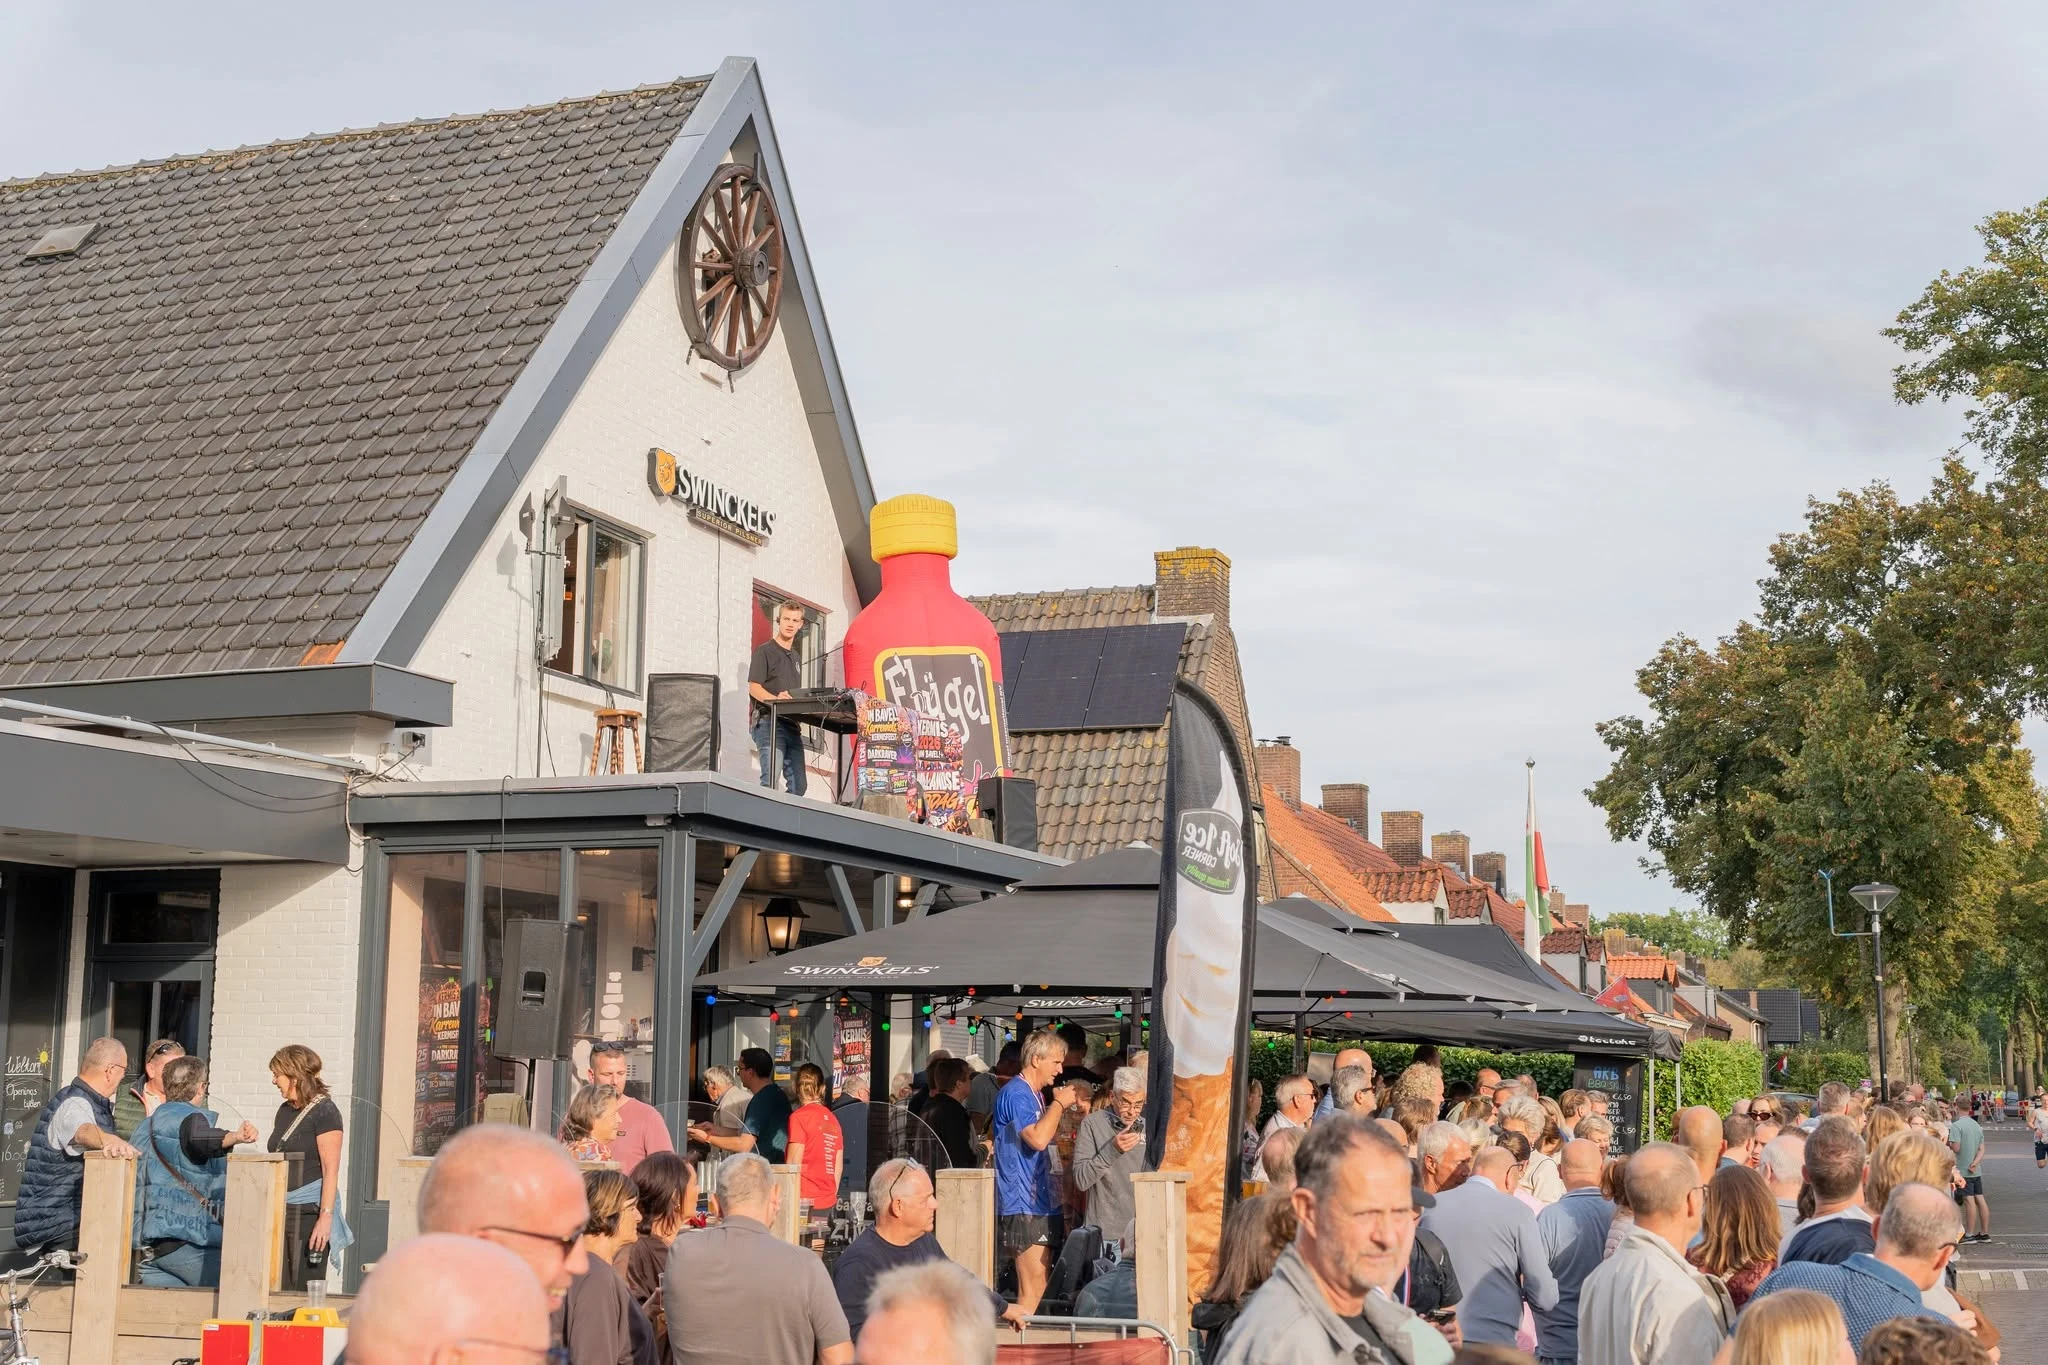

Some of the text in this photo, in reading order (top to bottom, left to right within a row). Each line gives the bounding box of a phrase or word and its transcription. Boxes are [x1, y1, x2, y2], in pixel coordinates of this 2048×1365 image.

[697, 511, 761, 546] SUPERIOR PILSNER
[884, 652, 990, 745] Flügel
[918, 719, 949, 738] KERMIS
[443, 1001, 460, 1018] BAV
[841, 1028, 866, 1044] KERMIS
[431, 1049, 459, 1062] DARKRA
[833, 1069, 841, 1088] 27
